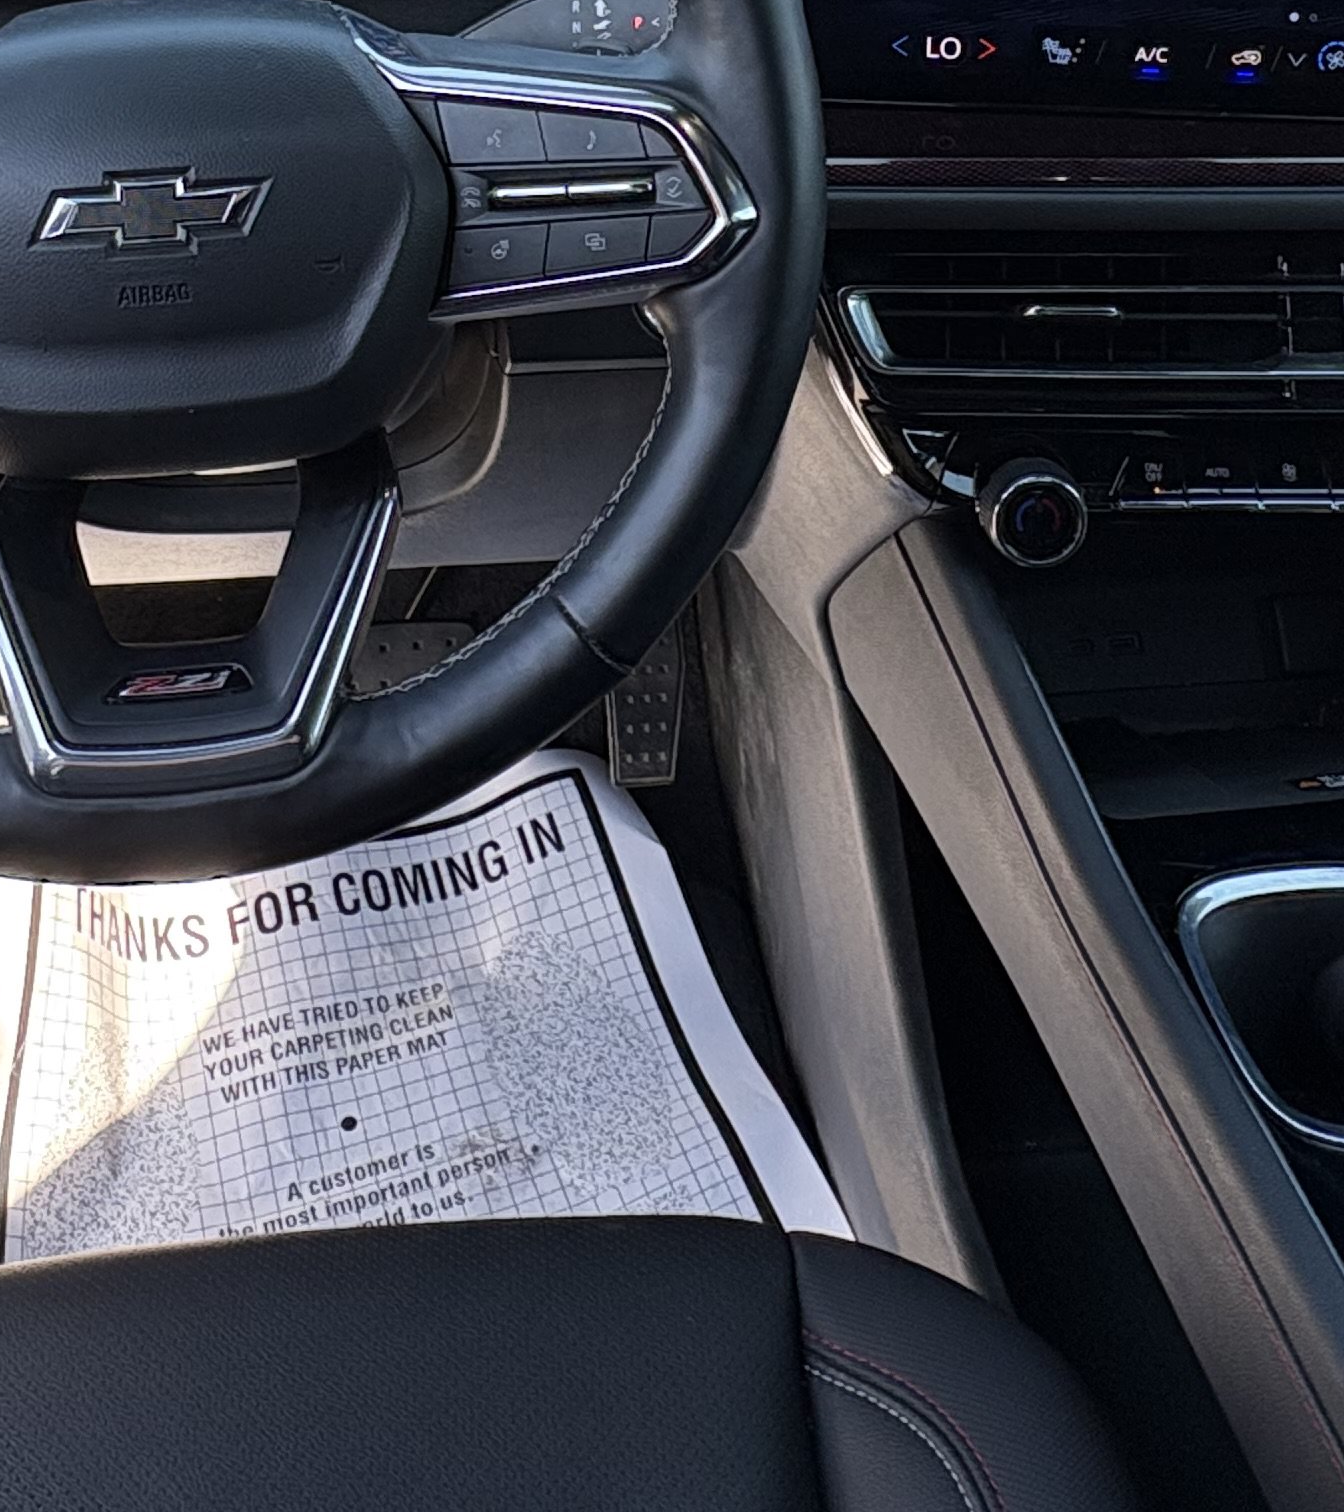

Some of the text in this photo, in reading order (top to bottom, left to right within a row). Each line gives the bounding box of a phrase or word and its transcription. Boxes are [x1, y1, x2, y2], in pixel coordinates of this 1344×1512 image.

[572, 0, 580, 13] R
[572, 21, 582, 34] N
[633, 16, 643, 29] P
[925, 35, 963, 62] LO
[1134, 46, 1169, 65] A/C
[117, 283, 191, 308] AIRBAG
[1204, 466, 1231, 479] AUTO
[75, 812, 567, 962] THANKS FOR COMING IN
[203, 982, 444, 1056] WE HAVE TRIED TO KEEP
[204, 1004, 454, 1081] YOUR CARPETING CLEAN
[220, 1030, 449, 1104] WITH THIS PAPER MAT
[287, 1143, 436, 1202] A customer is
[262, 1205, 318, 1234] most
[325, 1172, 433, 1218] important
[437, 1148, 512, 1186] person
[361, 1210, 407, 1229] orld
[411, 1201, 434, 1219] to
